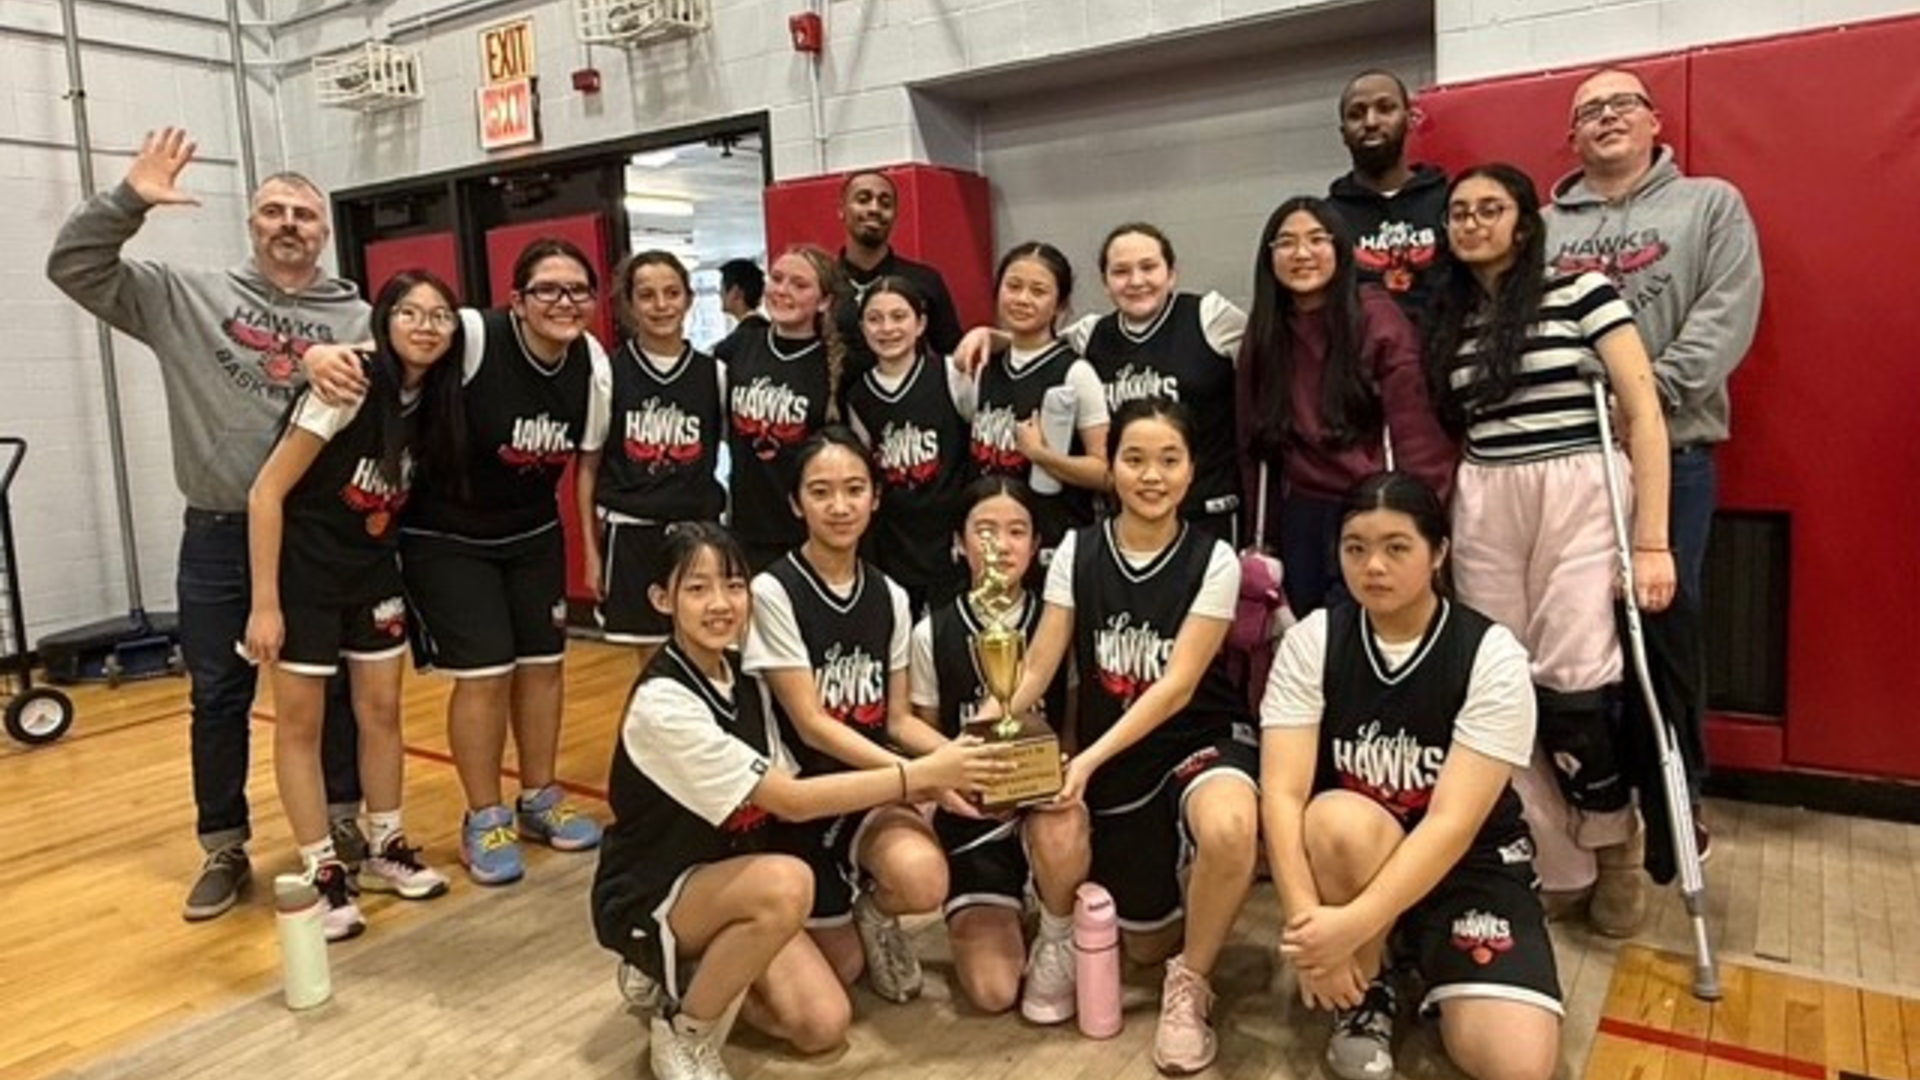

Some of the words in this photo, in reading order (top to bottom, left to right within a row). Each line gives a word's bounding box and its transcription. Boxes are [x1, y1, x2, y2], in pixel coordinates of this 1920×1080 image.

[486, 23, 526, 79] EXIT
[484, 86, 528, 136] EXIT
[1360, 227, 1434, 249] HAWKS
[1560, 227, 1660, 256] HAWKS
[233, 306, 334, 342] HAWKS
[732, 386, 809, 425] HAWKS
[626, 409, 701, 447] HAWKS
[1333, 738, 1444, 790] HAWKS
